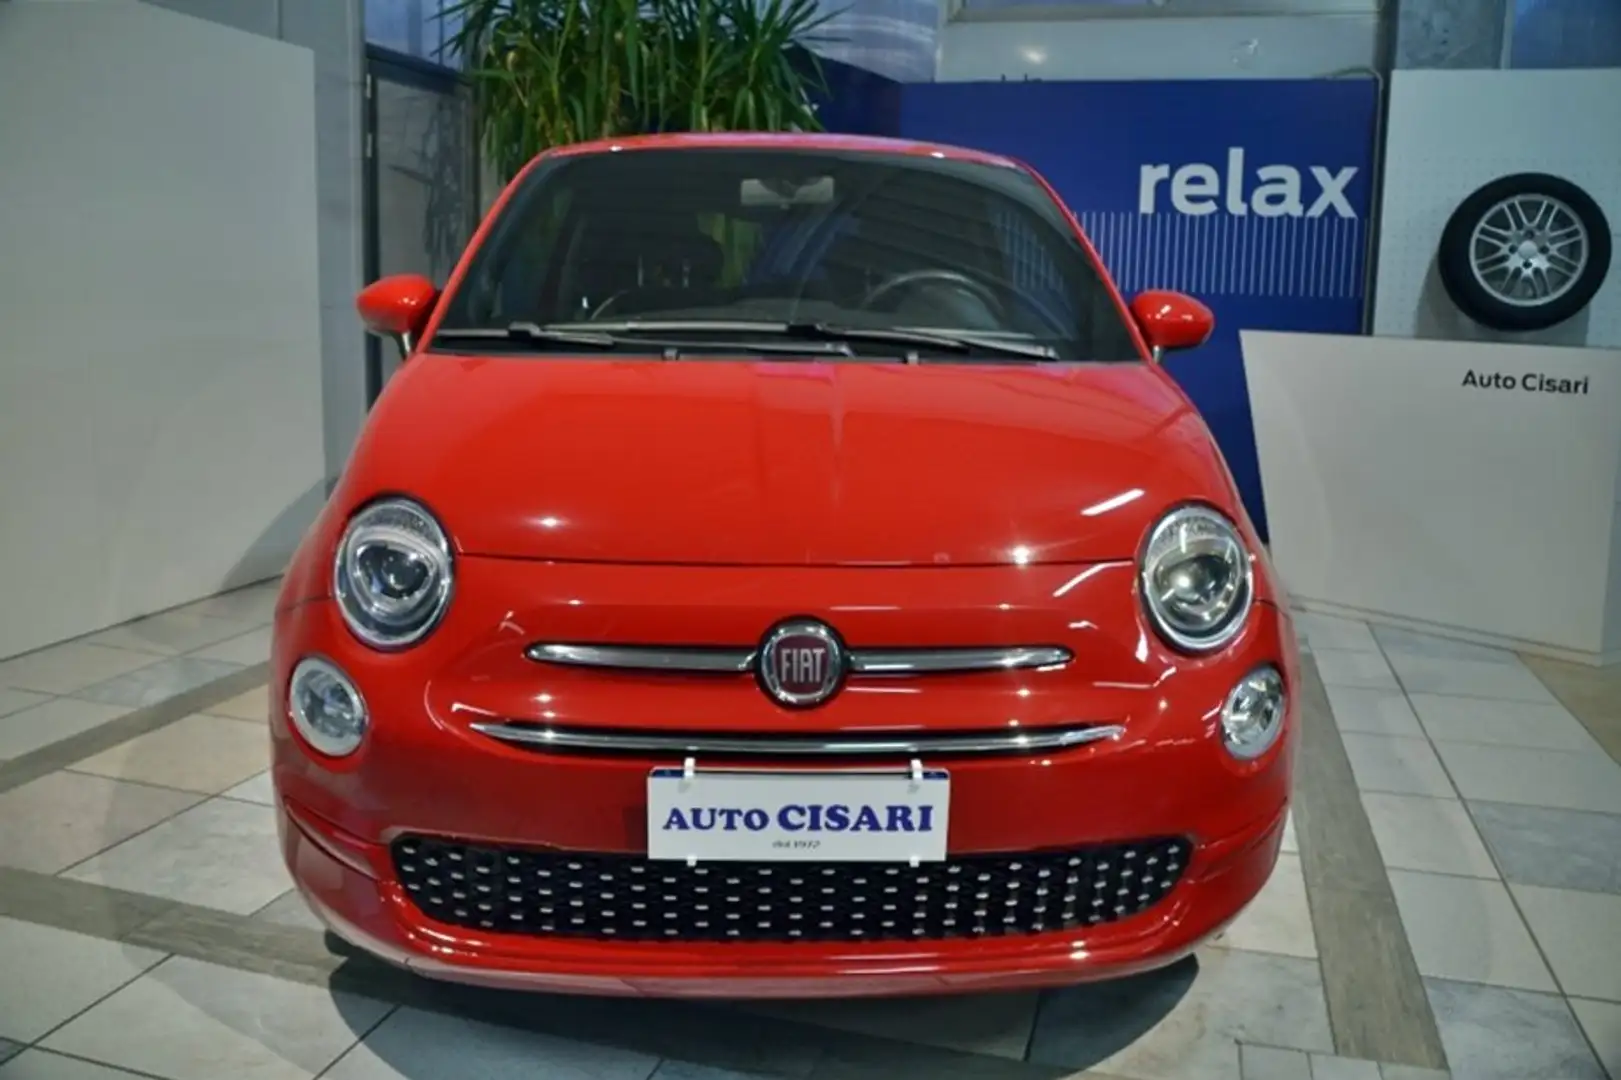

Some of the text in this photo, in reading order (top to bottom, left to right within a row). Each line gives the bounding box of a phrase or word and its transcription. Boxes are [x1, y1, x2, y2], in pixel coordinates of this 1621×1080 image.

[1139, 147, 1359, 219] relax
[1461, 368, 1590, 396] Auto Cisari
[781, 647, 826, 683] FIAT
[662, 804, 933, 832] AUTO CISARI
